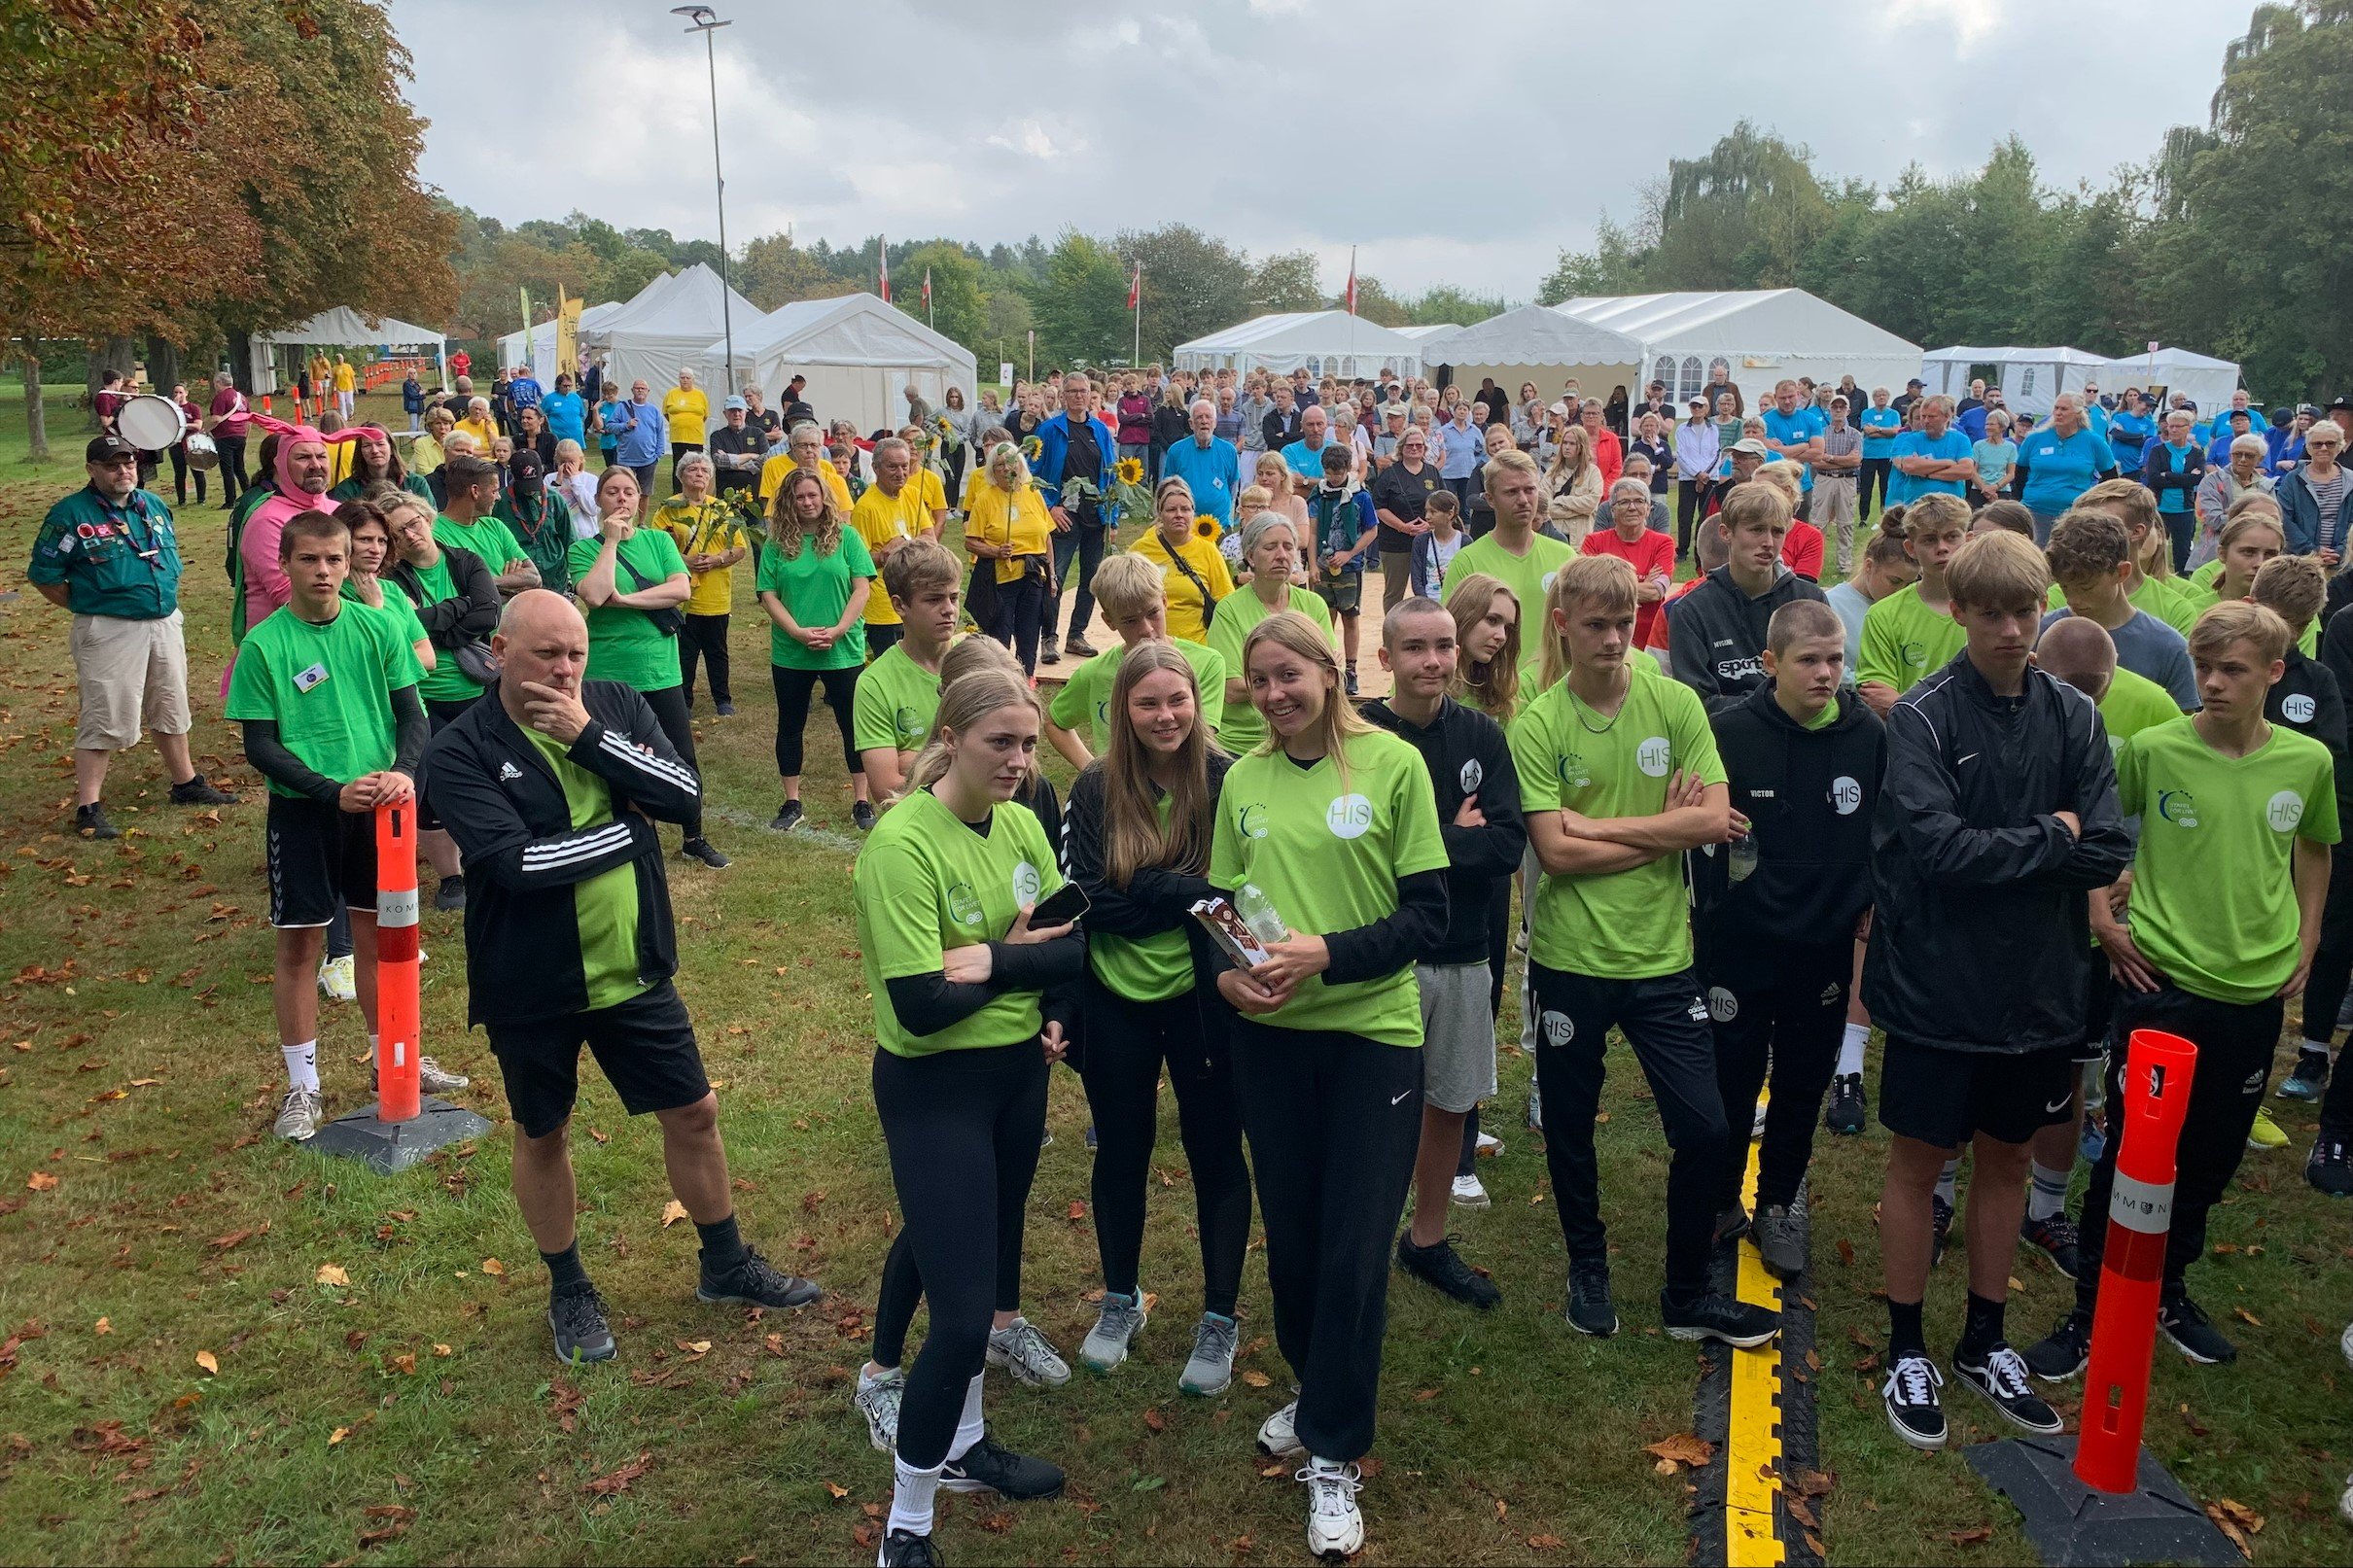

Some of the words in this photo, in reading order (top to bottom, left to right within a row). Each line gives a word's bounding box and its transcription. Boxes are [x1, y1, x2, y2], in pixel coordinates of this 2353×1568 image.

[2285, 701, 2314, 716] HIS
[1640, 747, 1670, 768] HIS
[499, 771, 523, 782] adidas
[1750, 789, 1774, 798] VICTOR
[1330, 804, 1370, 825] HIS
[2269, 803, 2301, 822] HIS
